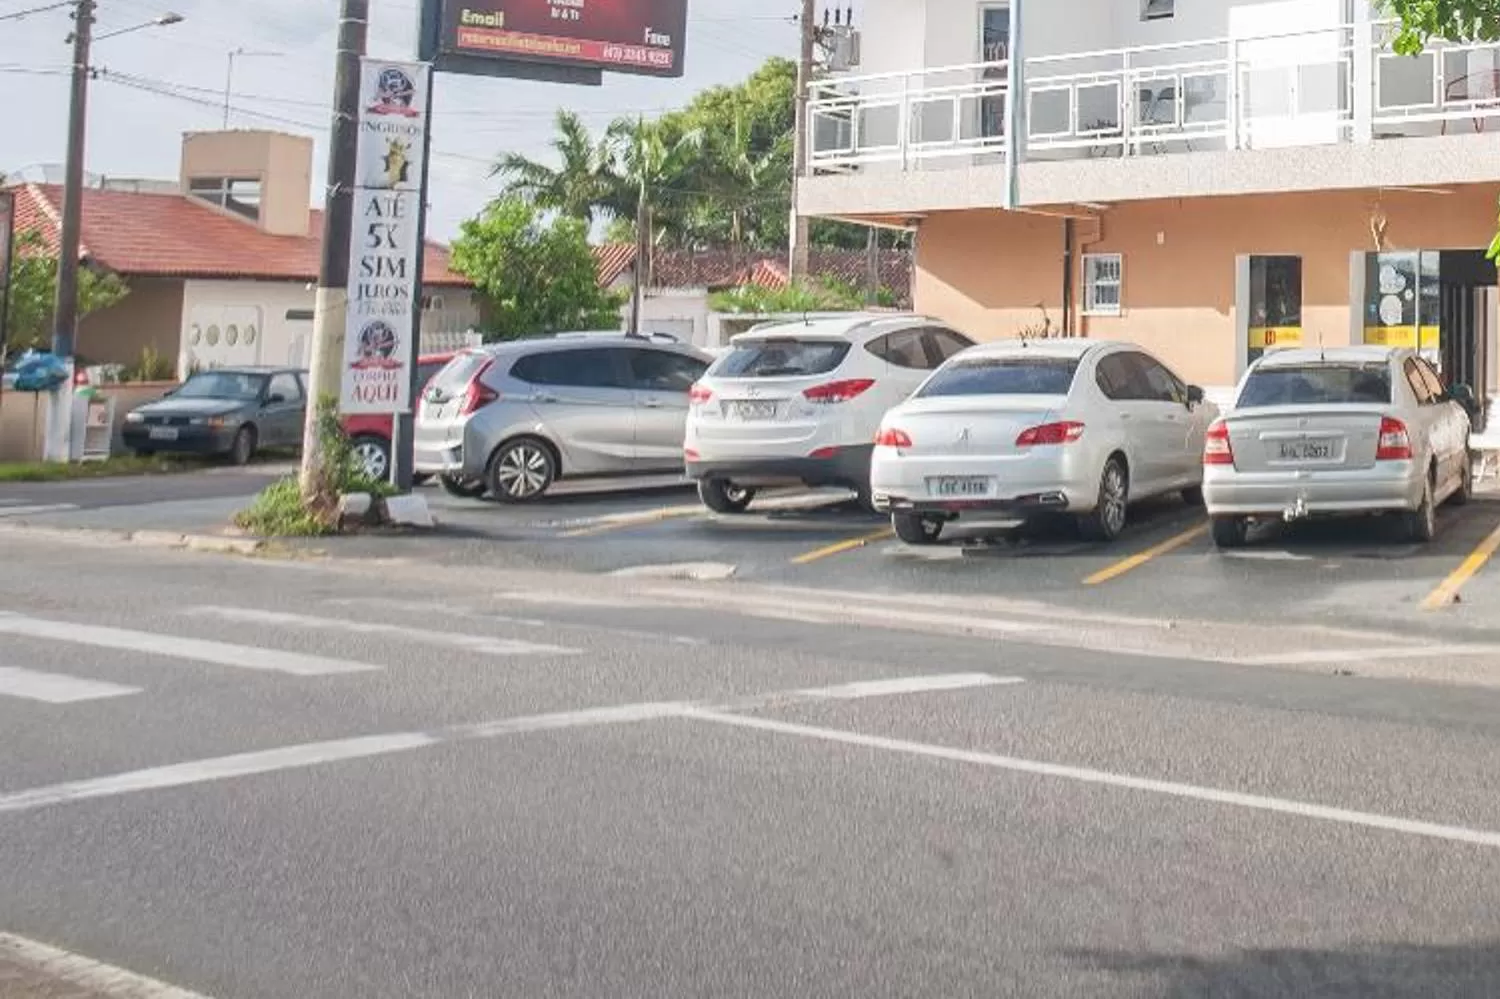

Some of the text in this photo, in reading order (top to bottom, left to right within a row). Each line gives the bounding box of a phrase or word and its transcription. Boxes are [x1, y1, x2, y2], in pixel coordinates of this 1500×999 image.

[461, 8, 504, 28] Email
[364, 191, 405, 218] ATÉ
[355, 283, 409, 301] JUROS
[351, 383, 400, 404] AQUI
